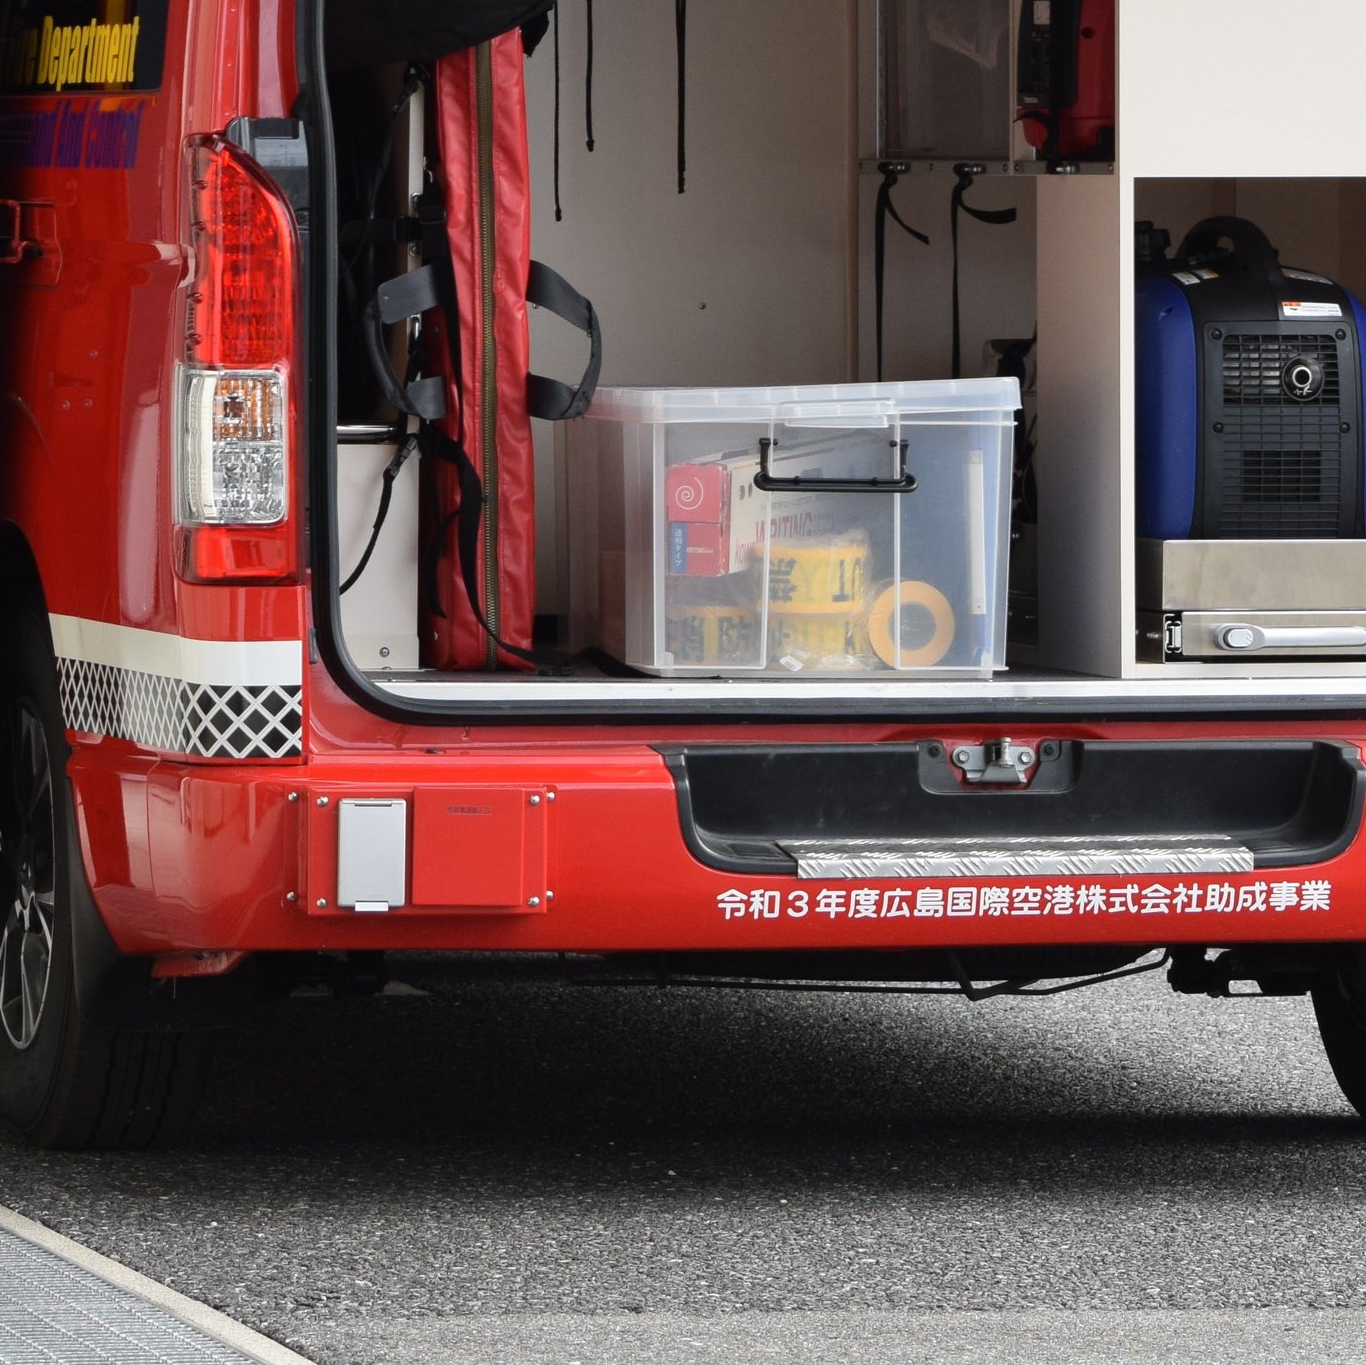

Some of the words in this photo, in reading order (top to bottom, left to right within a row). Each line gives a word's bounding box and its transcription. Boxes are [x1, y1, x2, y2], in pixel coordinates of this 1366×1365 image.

[37, 14, 139, 93] Department
[715, 879, 1331, 920] 令和3年度広島国際空港株式会社助成事業
